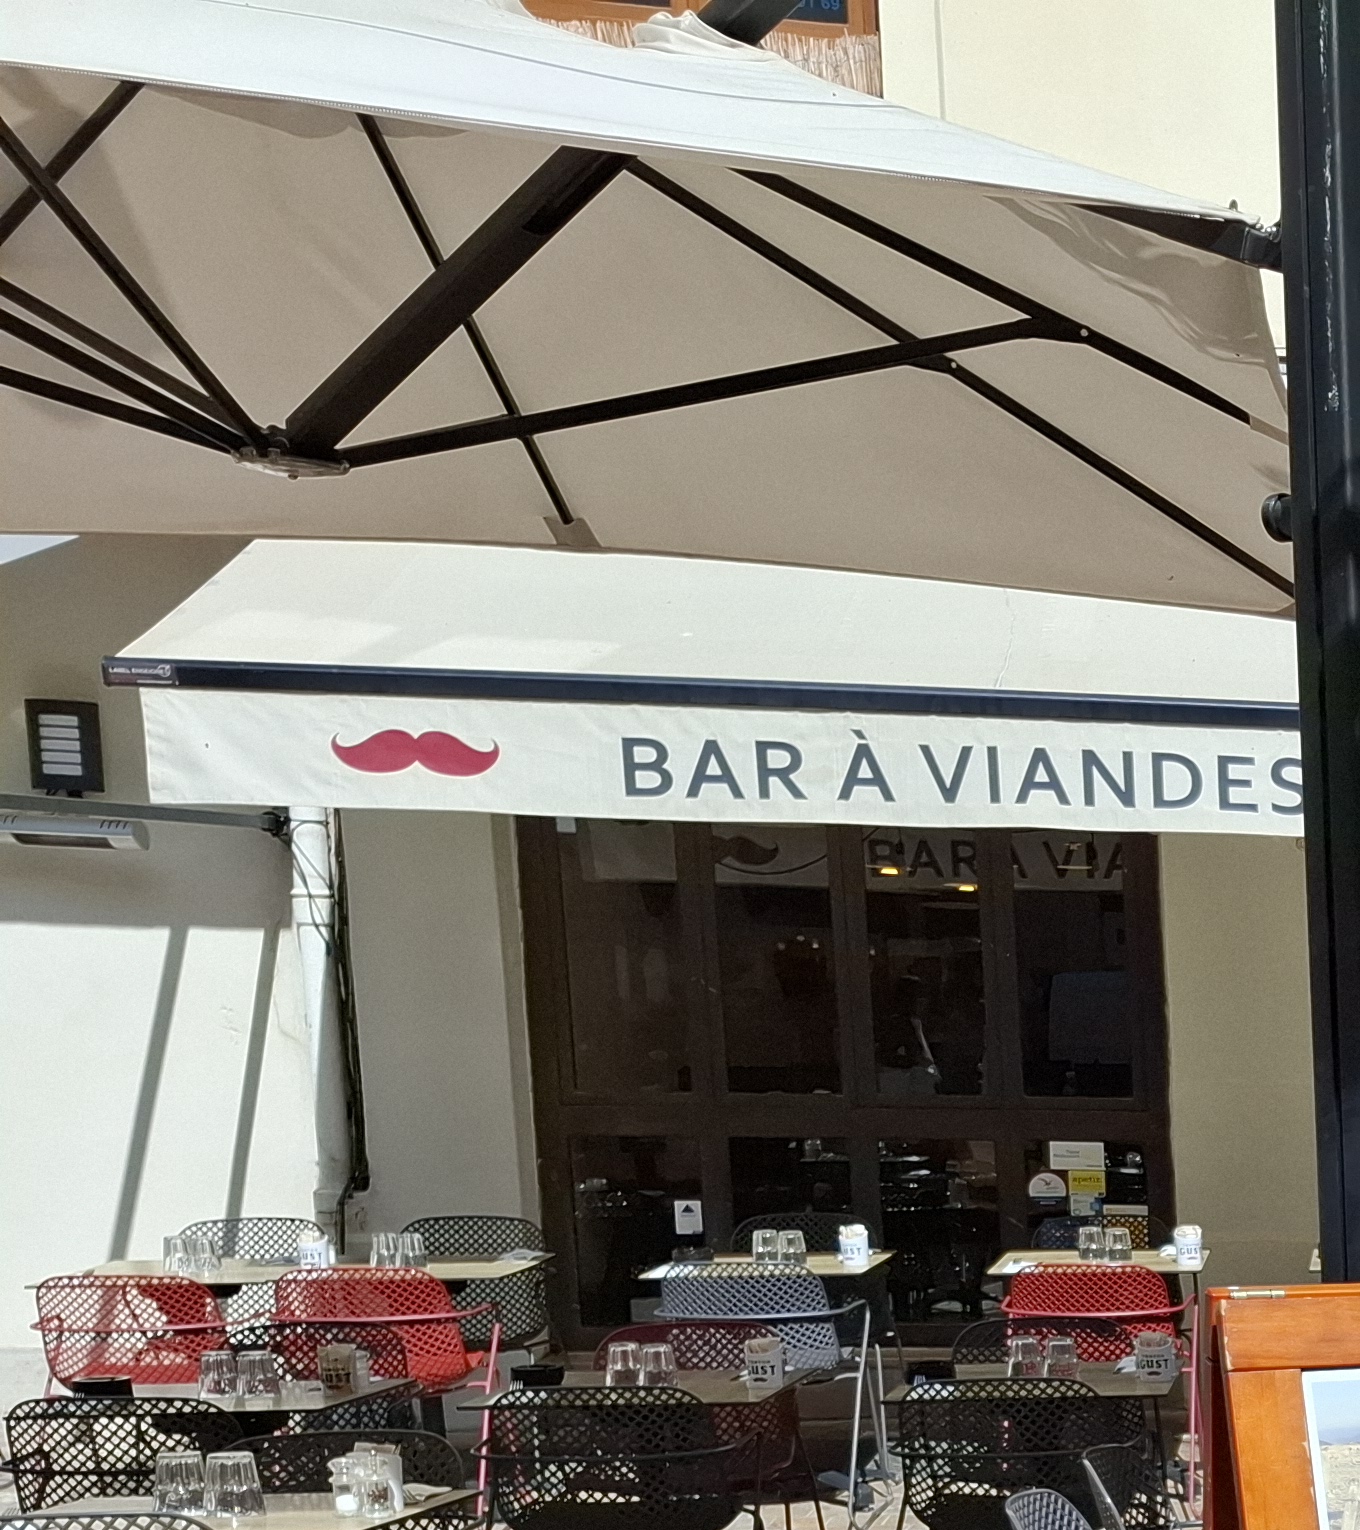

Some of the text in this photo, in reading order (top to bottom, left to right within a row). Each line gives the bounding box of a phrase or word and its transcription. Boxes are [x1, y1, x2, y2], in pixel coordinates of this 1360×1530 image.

[620, 737, 808, 801] BAR
[837, 729, 896, 803] À
[918, 743, 1303, 817] VIANDES
